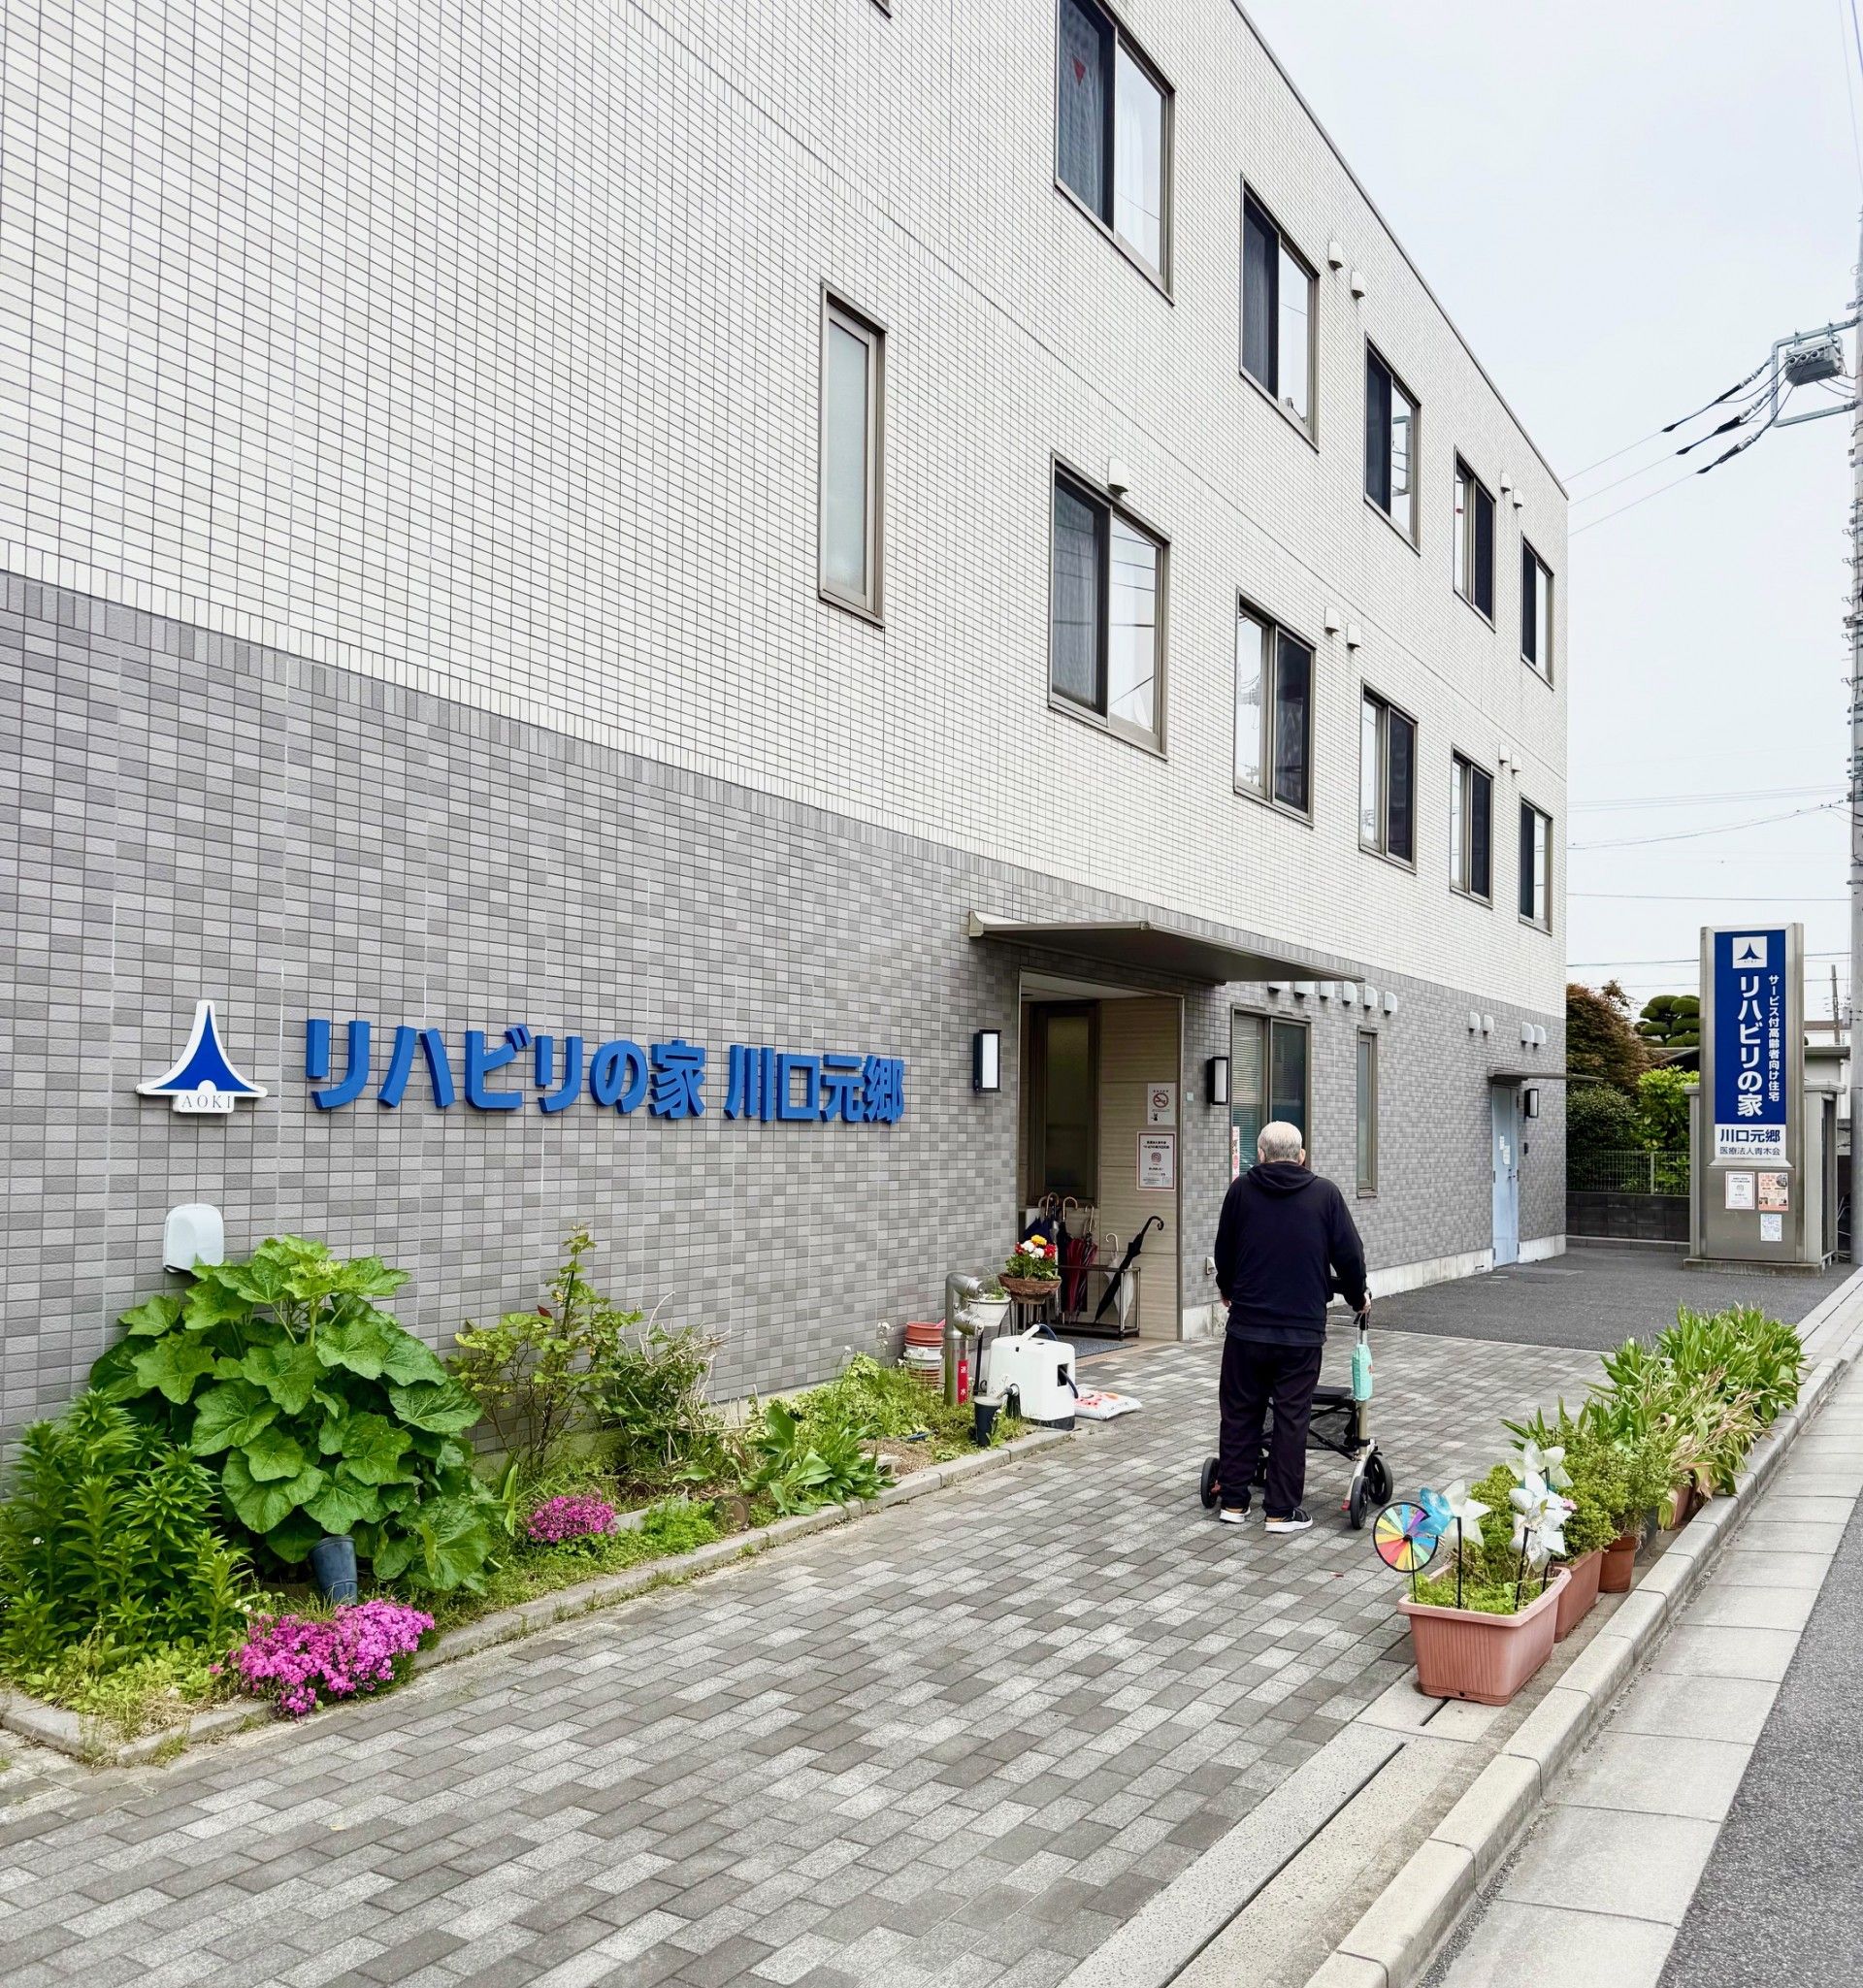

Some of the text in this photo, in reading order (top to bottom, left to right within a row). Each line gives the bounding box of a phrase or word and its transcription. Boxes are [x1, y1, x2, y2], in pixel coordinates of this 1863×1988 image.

[1737, 975, 1763, 1117] リハビリの家
[1768, 974, 1781, 1102] サービス付高齢者向け住宅
[181, 1094, 231, 1109] AOKI
[307, 1019, 905, 1124] リハビリの家 川口元郷
[1719, 1146, 1781, 1156] 医療法人青木会
[1720, 1128, 1781, 1143] 川口元郷
